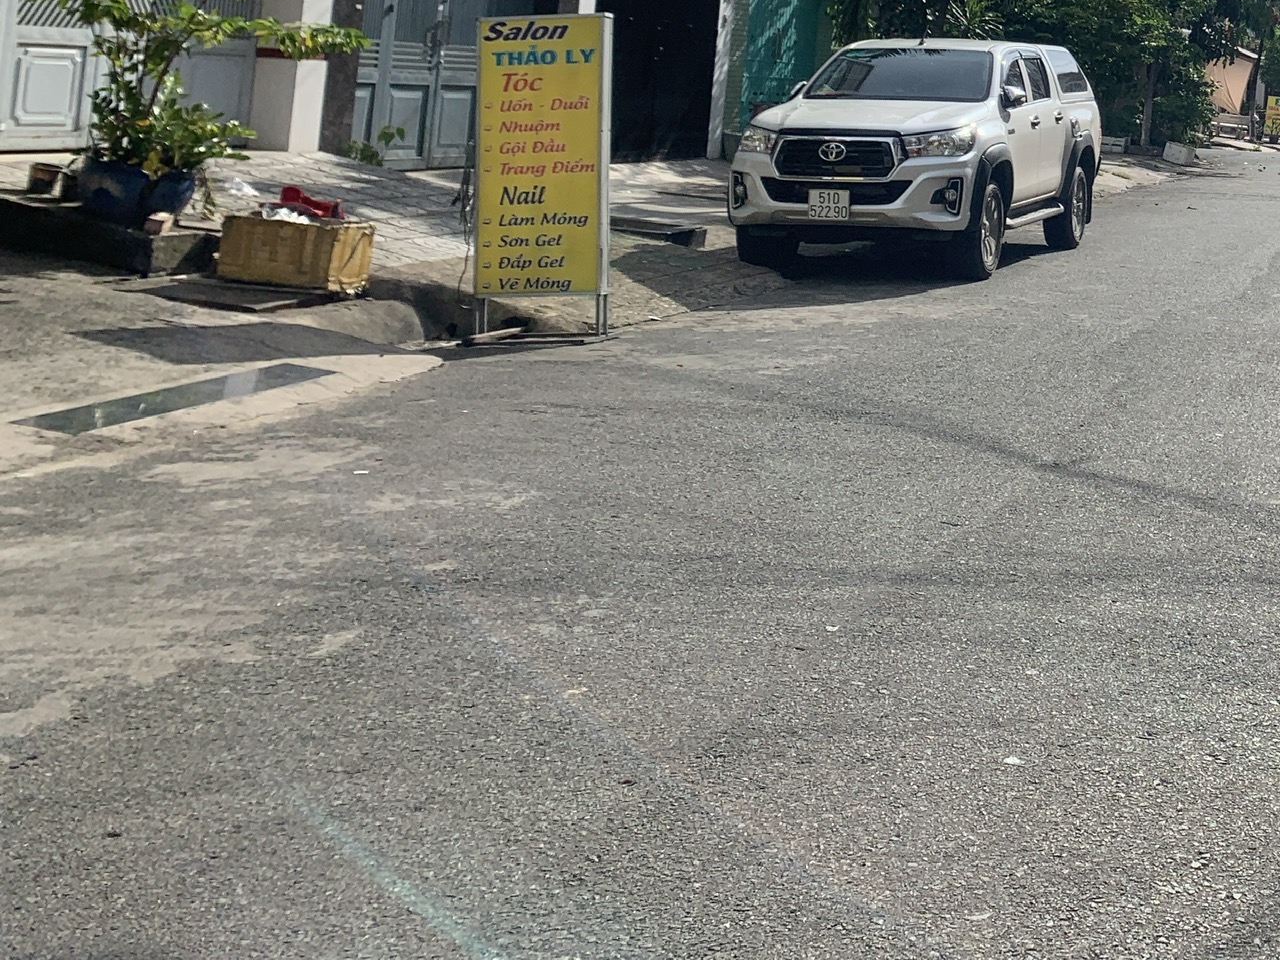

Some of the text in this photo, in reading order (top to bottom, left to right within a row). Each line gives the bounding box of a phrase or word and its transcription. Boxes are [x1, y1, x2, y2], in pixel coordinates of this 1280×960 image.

[483, 21, 569, 42] Salon
[491, 44, 596, 66] THẢO LY
[502, 72, 543, 92] Tóc
[500, 99, 533, 113] Uốn
[550, 95, 590, 111] Duỗi
[499, 120, 560, 135] Nhuộm
[499, 138, 566, 156] Gội Đầu
[500, 162, 546, 177] Trang
[500, 185, 546, 205] Nail
[818, 191, 840, 205] 51D
[499, 212, 589, 227] Làm Móng
[810, 204, 848, 219] 522.90
[498, 233, 563, 248] Sơn Gel
[498, 253, 565, 271] Đắp Gel
[498, 276, 572, 292] Vẽ Móng
